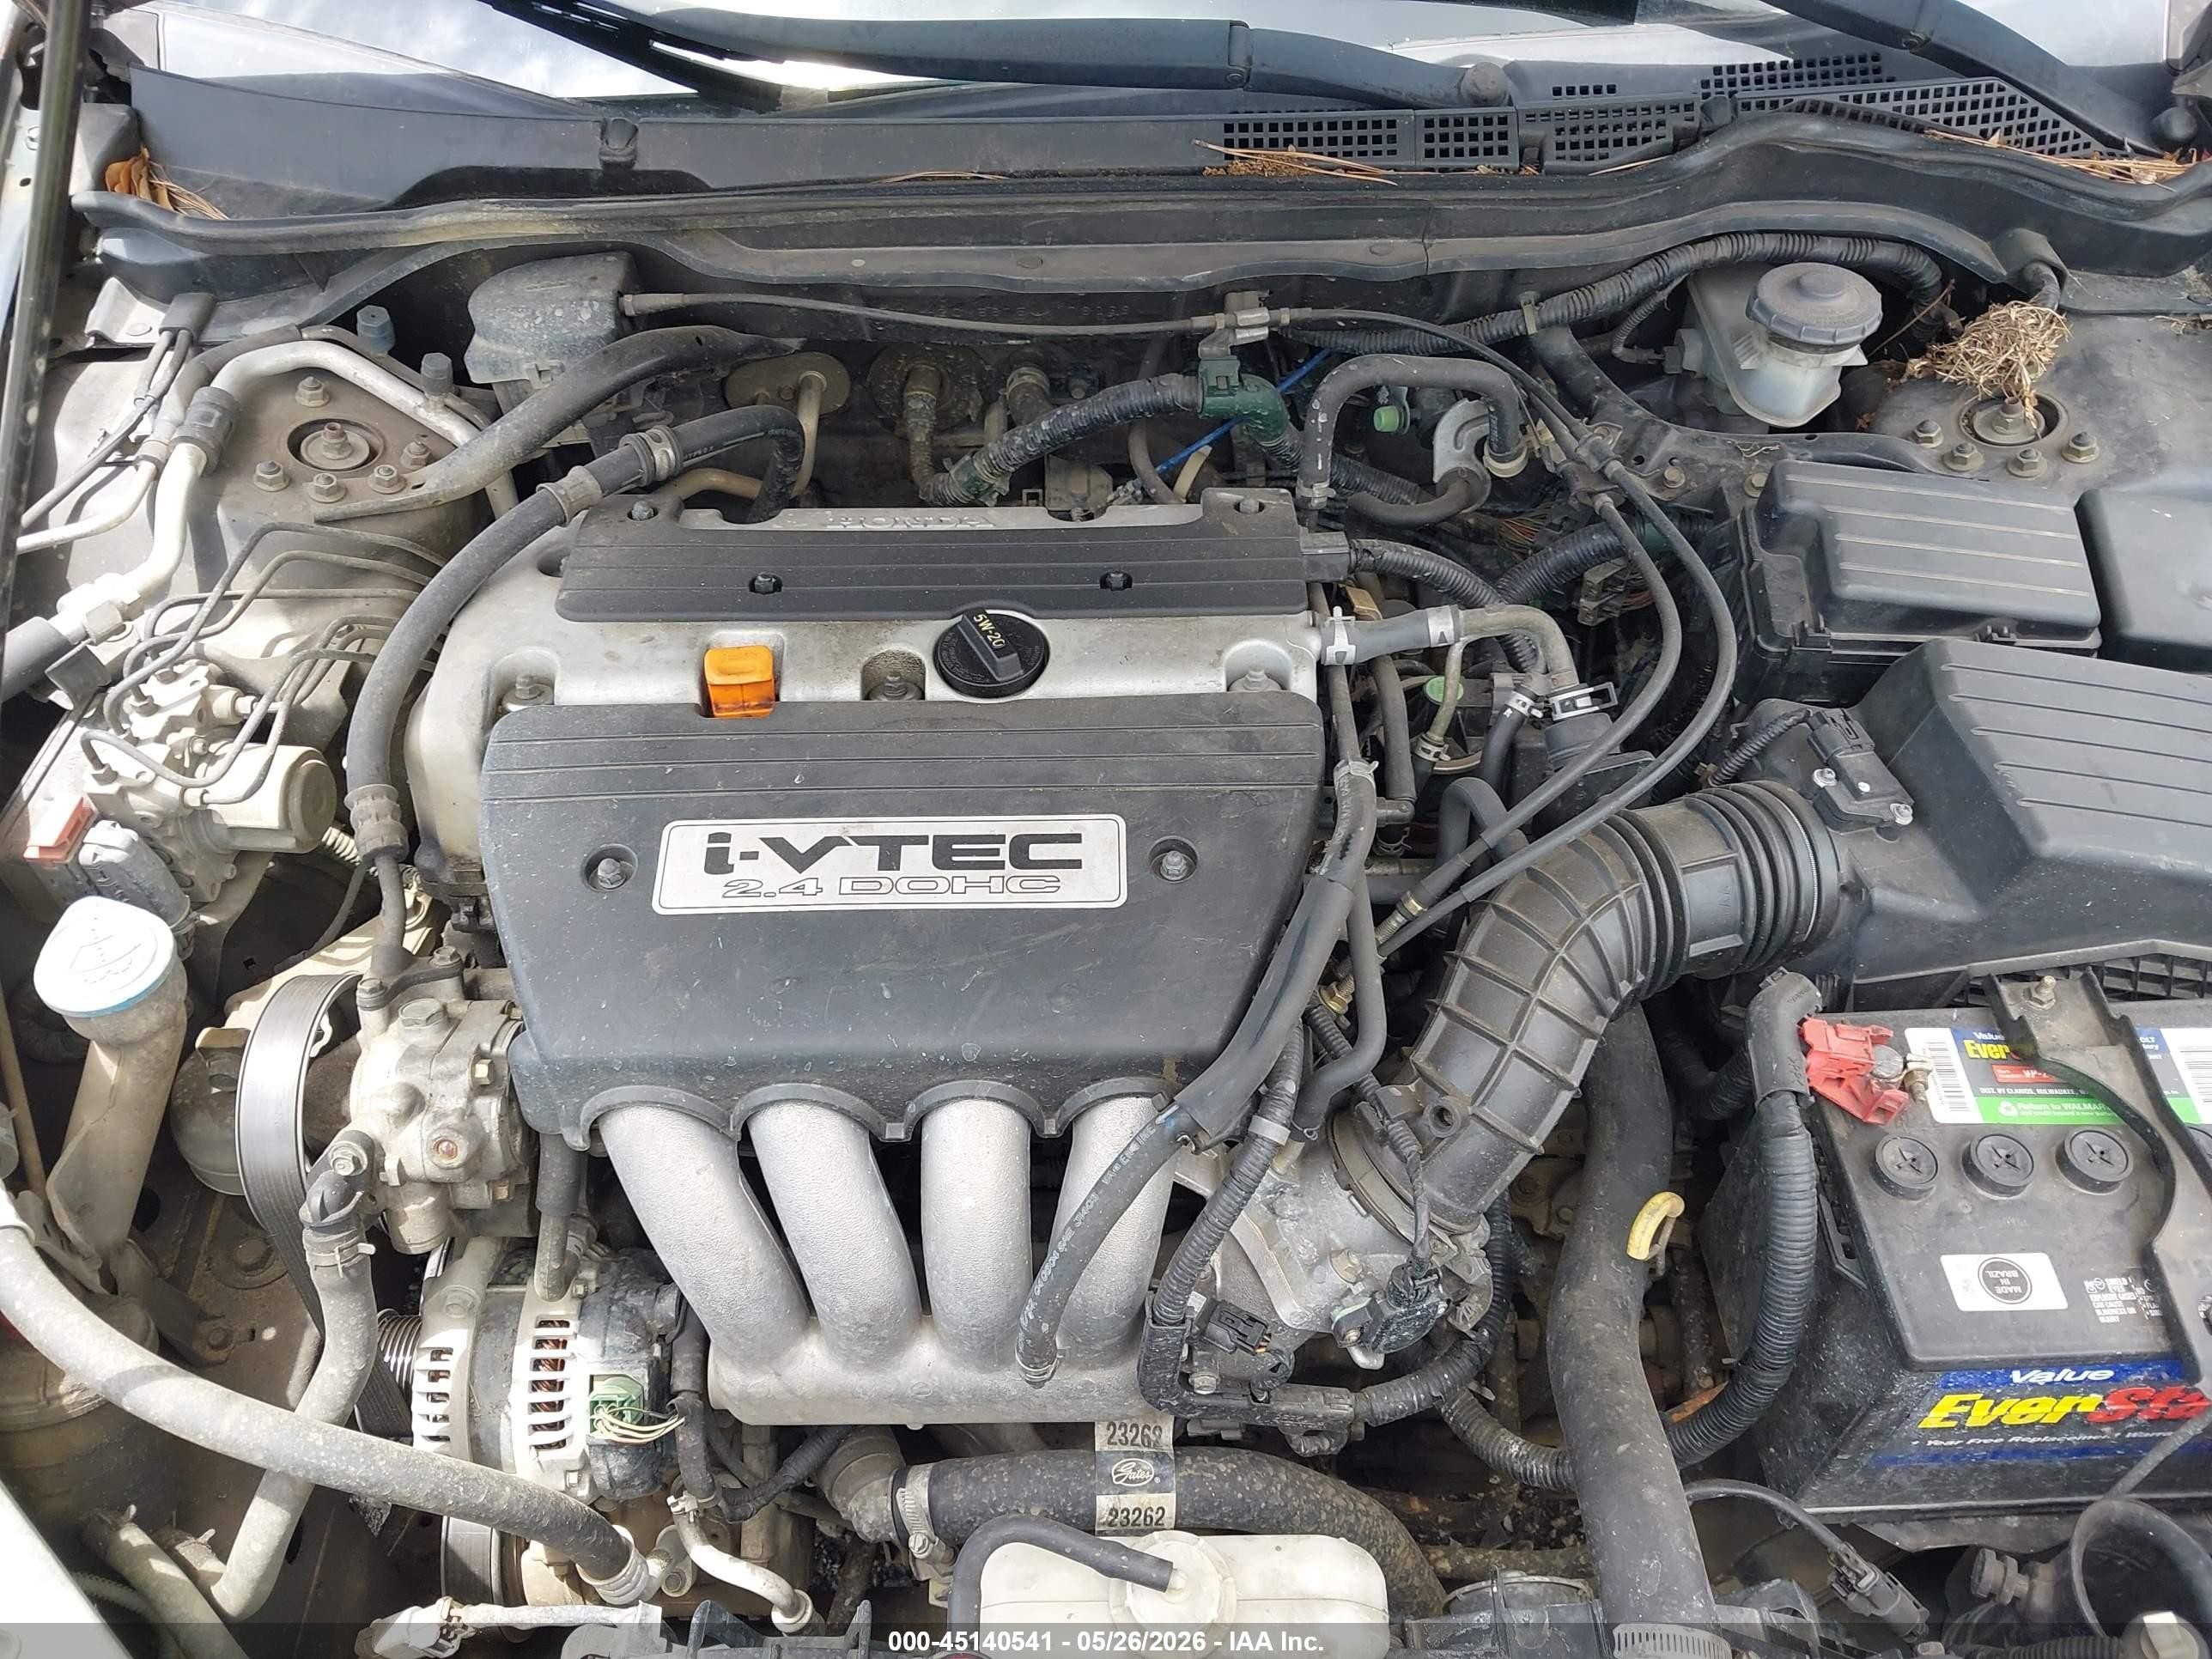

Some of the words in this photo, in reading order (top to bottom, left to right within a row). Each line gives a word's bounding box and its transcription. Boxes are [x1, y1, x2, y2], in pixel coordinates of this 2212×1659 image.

[973, 613, 1006, 649] 5W-20
[703, 831, 1083, 876] i-VTEC
[721, 877, 823, 898] 2.4
[838, 874, 1061, 896] DOHC
[1972, 1031, 2006, 1041] Value
[1963, 1039, 2021, 1061] Ever
[2063, 1103, 2111, 1111] WALMAR
[1994, 1285, 2022, 1294] MADE
[2010, 1368, 2114, 1385] Value
[1966, 1437, 2004, 1446] Free
[1113, 1460, 1153, 1485] Gates
[1107, 1505, 1166, 1528] 23262
